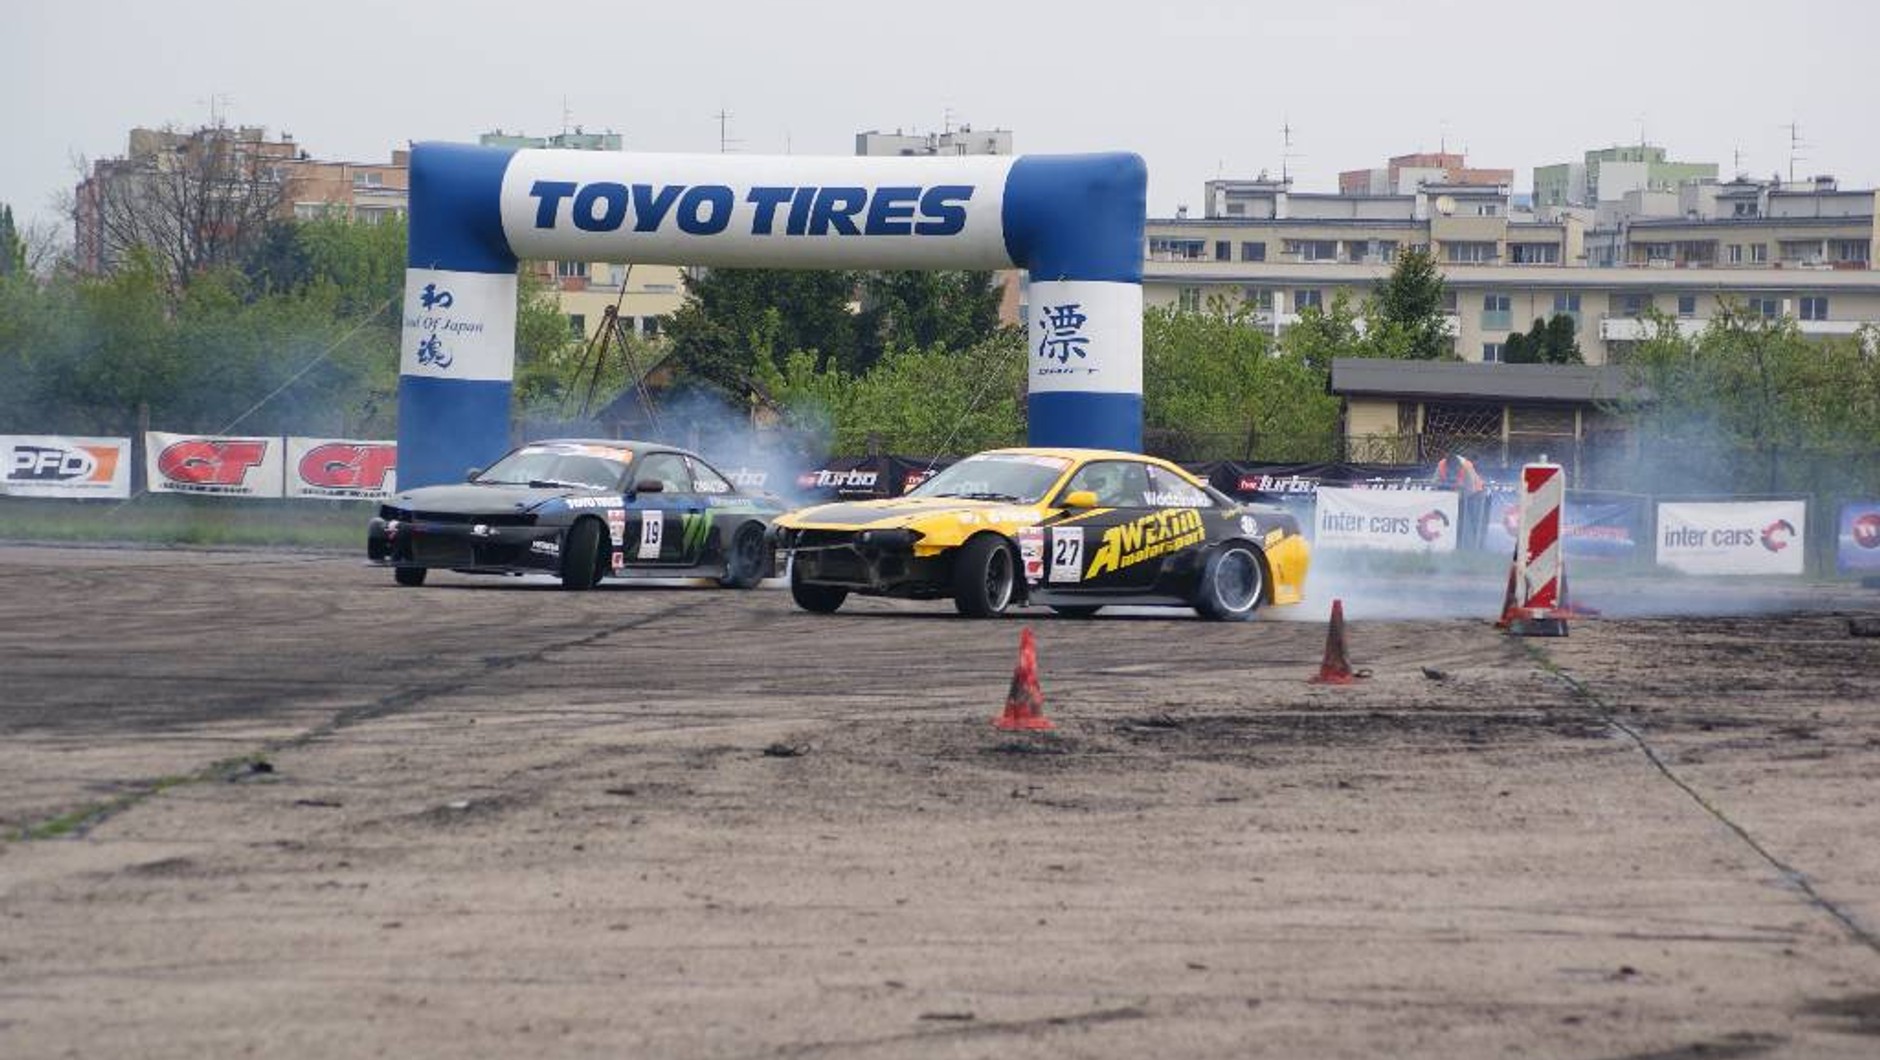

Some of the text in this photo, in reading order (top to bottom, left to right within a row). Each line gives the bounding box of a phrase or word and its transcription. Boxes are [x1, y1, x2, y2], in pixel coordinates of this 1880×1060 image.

[529, 180, 975, 236] TOYO TIRES
[441, 319, 484, 335] Japan
[1039, 304, 1090, 364] 漂
[645, 520, 659, 544] 19
[1322, 509, 1409, 535] inter cars
[1664, 524, 1754, 547] inter cars
[1056, 539, 1079, 566] 27
